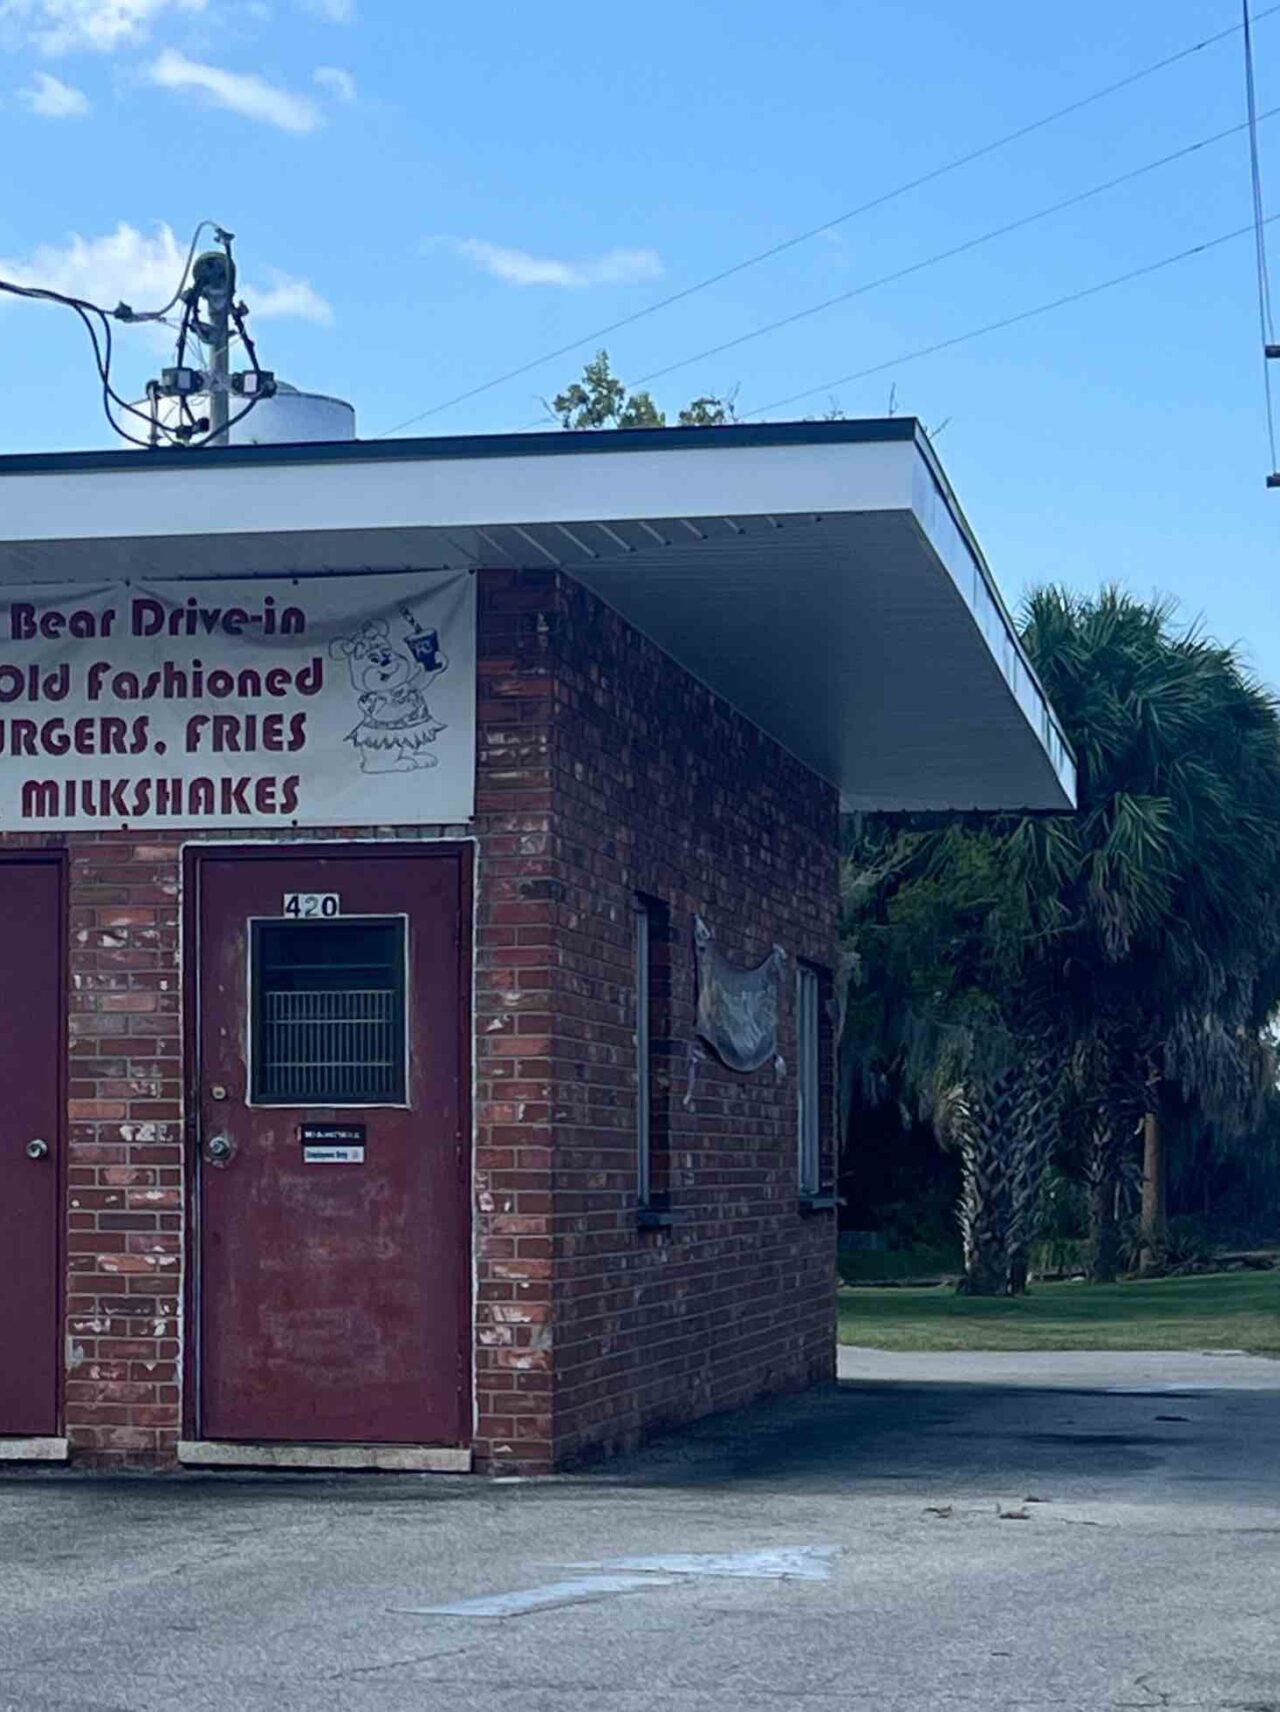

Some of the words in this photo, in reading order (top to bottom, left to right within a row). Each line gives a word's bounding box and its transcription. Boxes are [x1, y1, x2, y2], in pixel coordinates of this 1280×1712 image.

[10, 602, 115, 640] Bear
[131, 596, 306, 637] Drive-in
[87, 657, 324, 699] Fashioned
[185, 712, 307, 754] FRIES
[21, 775, 299, 818] MILKSHAKES
[286, 895, 338, 918] 420
